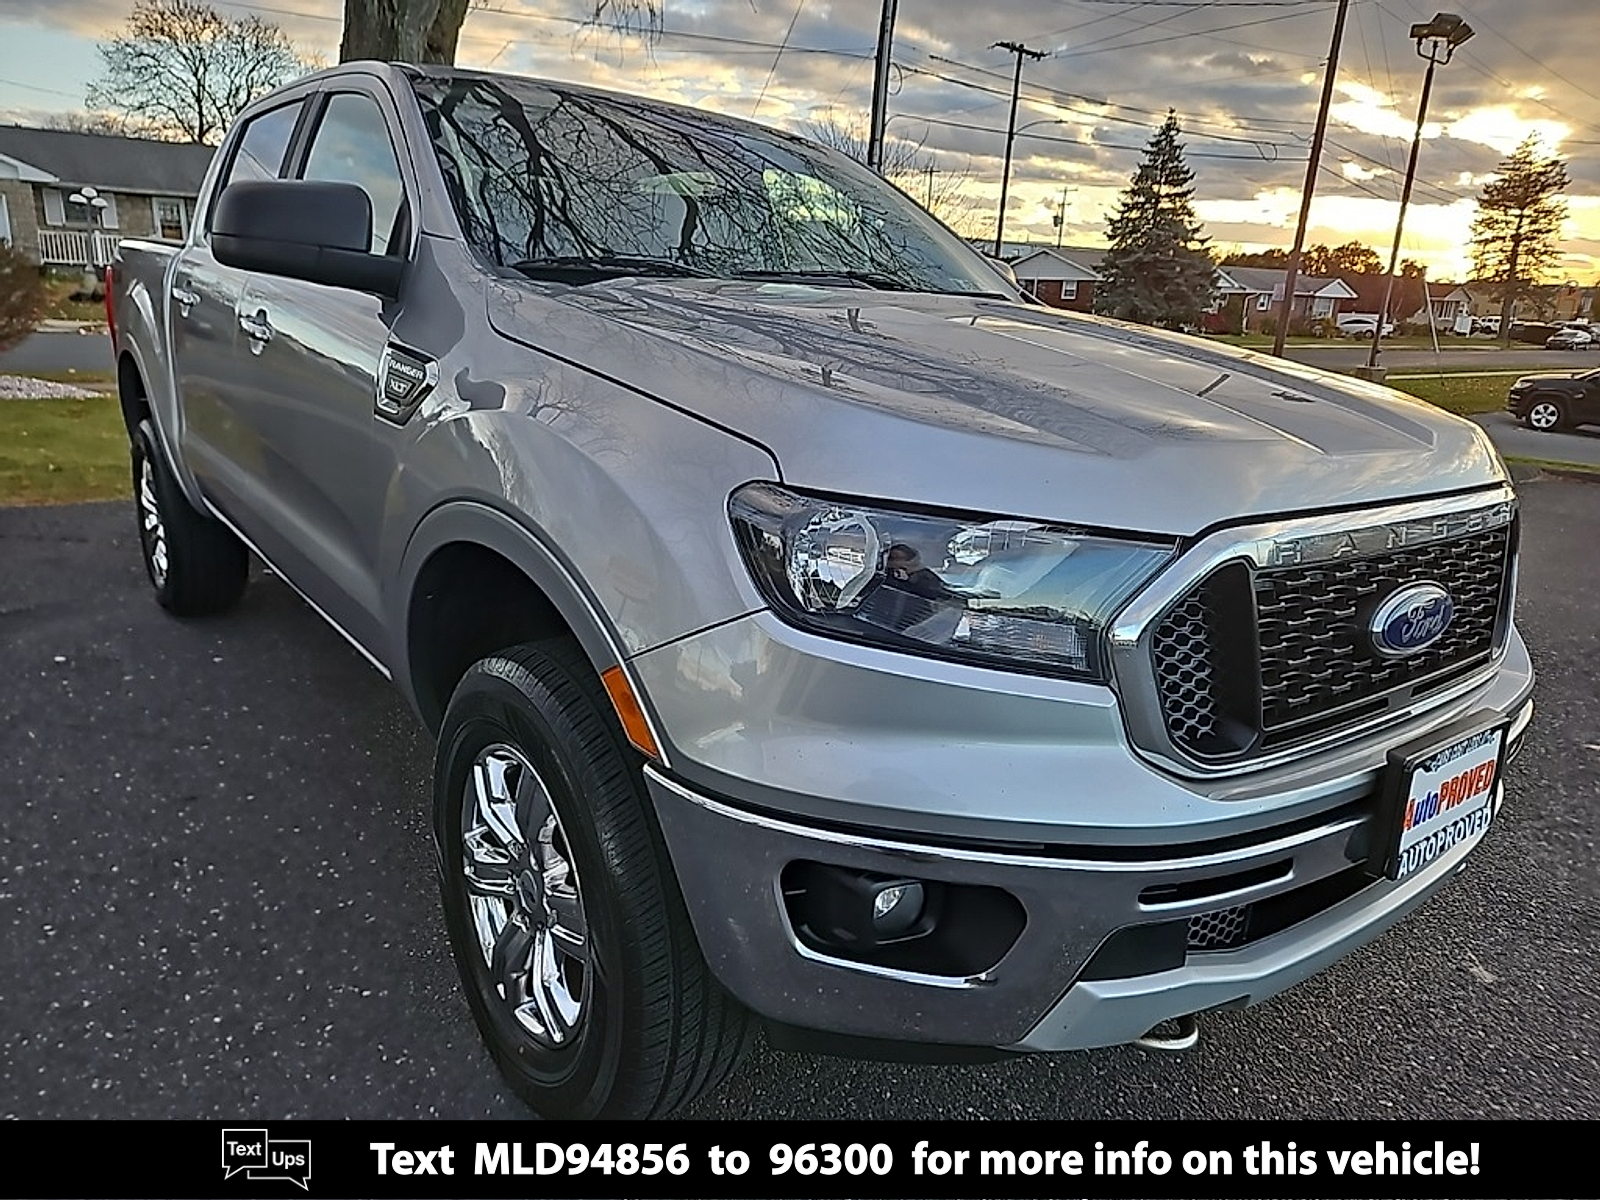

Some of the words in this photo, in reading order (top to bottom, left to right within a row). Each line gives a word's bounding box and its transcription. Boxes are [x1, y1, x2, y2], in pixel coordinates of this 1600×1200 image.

[389, 359, 424, 379] RANGER
[390, 380, 408, 393] XLT
[1401, 598, 1446, 644] Ford
[1403, 758, 1496, 832] AutoPROVED
[1397, 806, 1492, 880] AUTOPROVED
